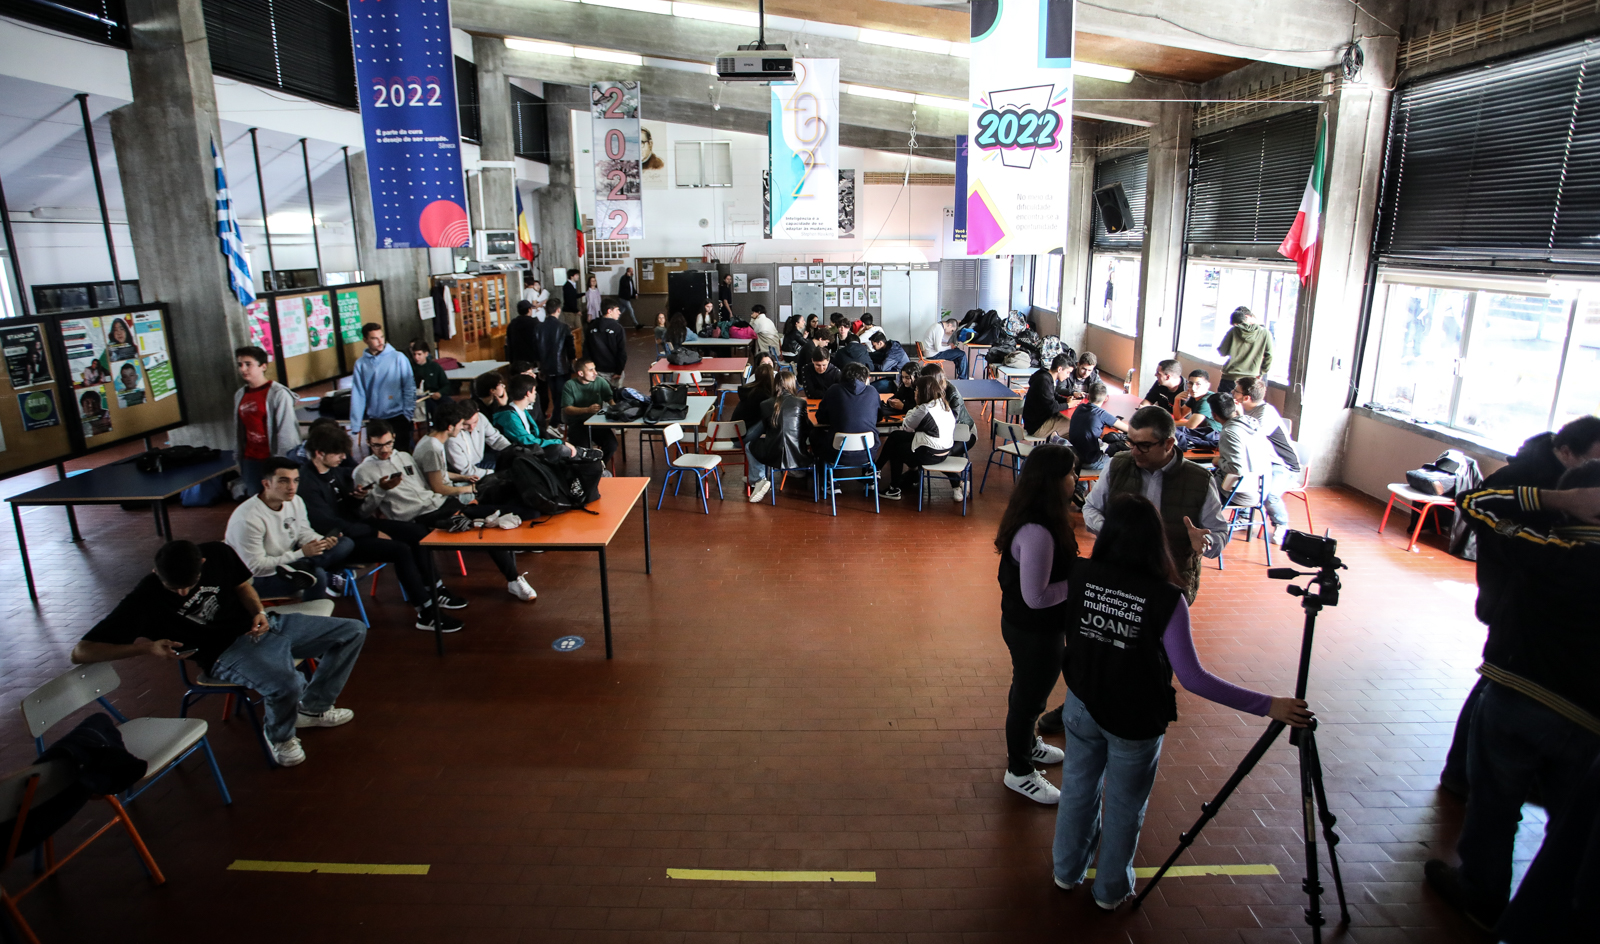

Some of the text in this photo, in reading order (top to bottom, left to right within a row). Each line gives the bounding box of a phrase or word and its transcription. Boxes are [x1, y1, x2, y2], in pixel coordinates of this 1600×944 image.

[373, 84, 443, 107] 2022
[382, 136, 403, 144] desejo
[976, 110, 1060, 148] 2022
[6, 332, 35, 340] STAND-UP
[1084, 590, 1143, 612] de técnico de
[1085, 583, 1146, 604] curso profissional
[1083, 599, 1141, 623] multimédia
[1080, 613, 1140, 638] JOANE
